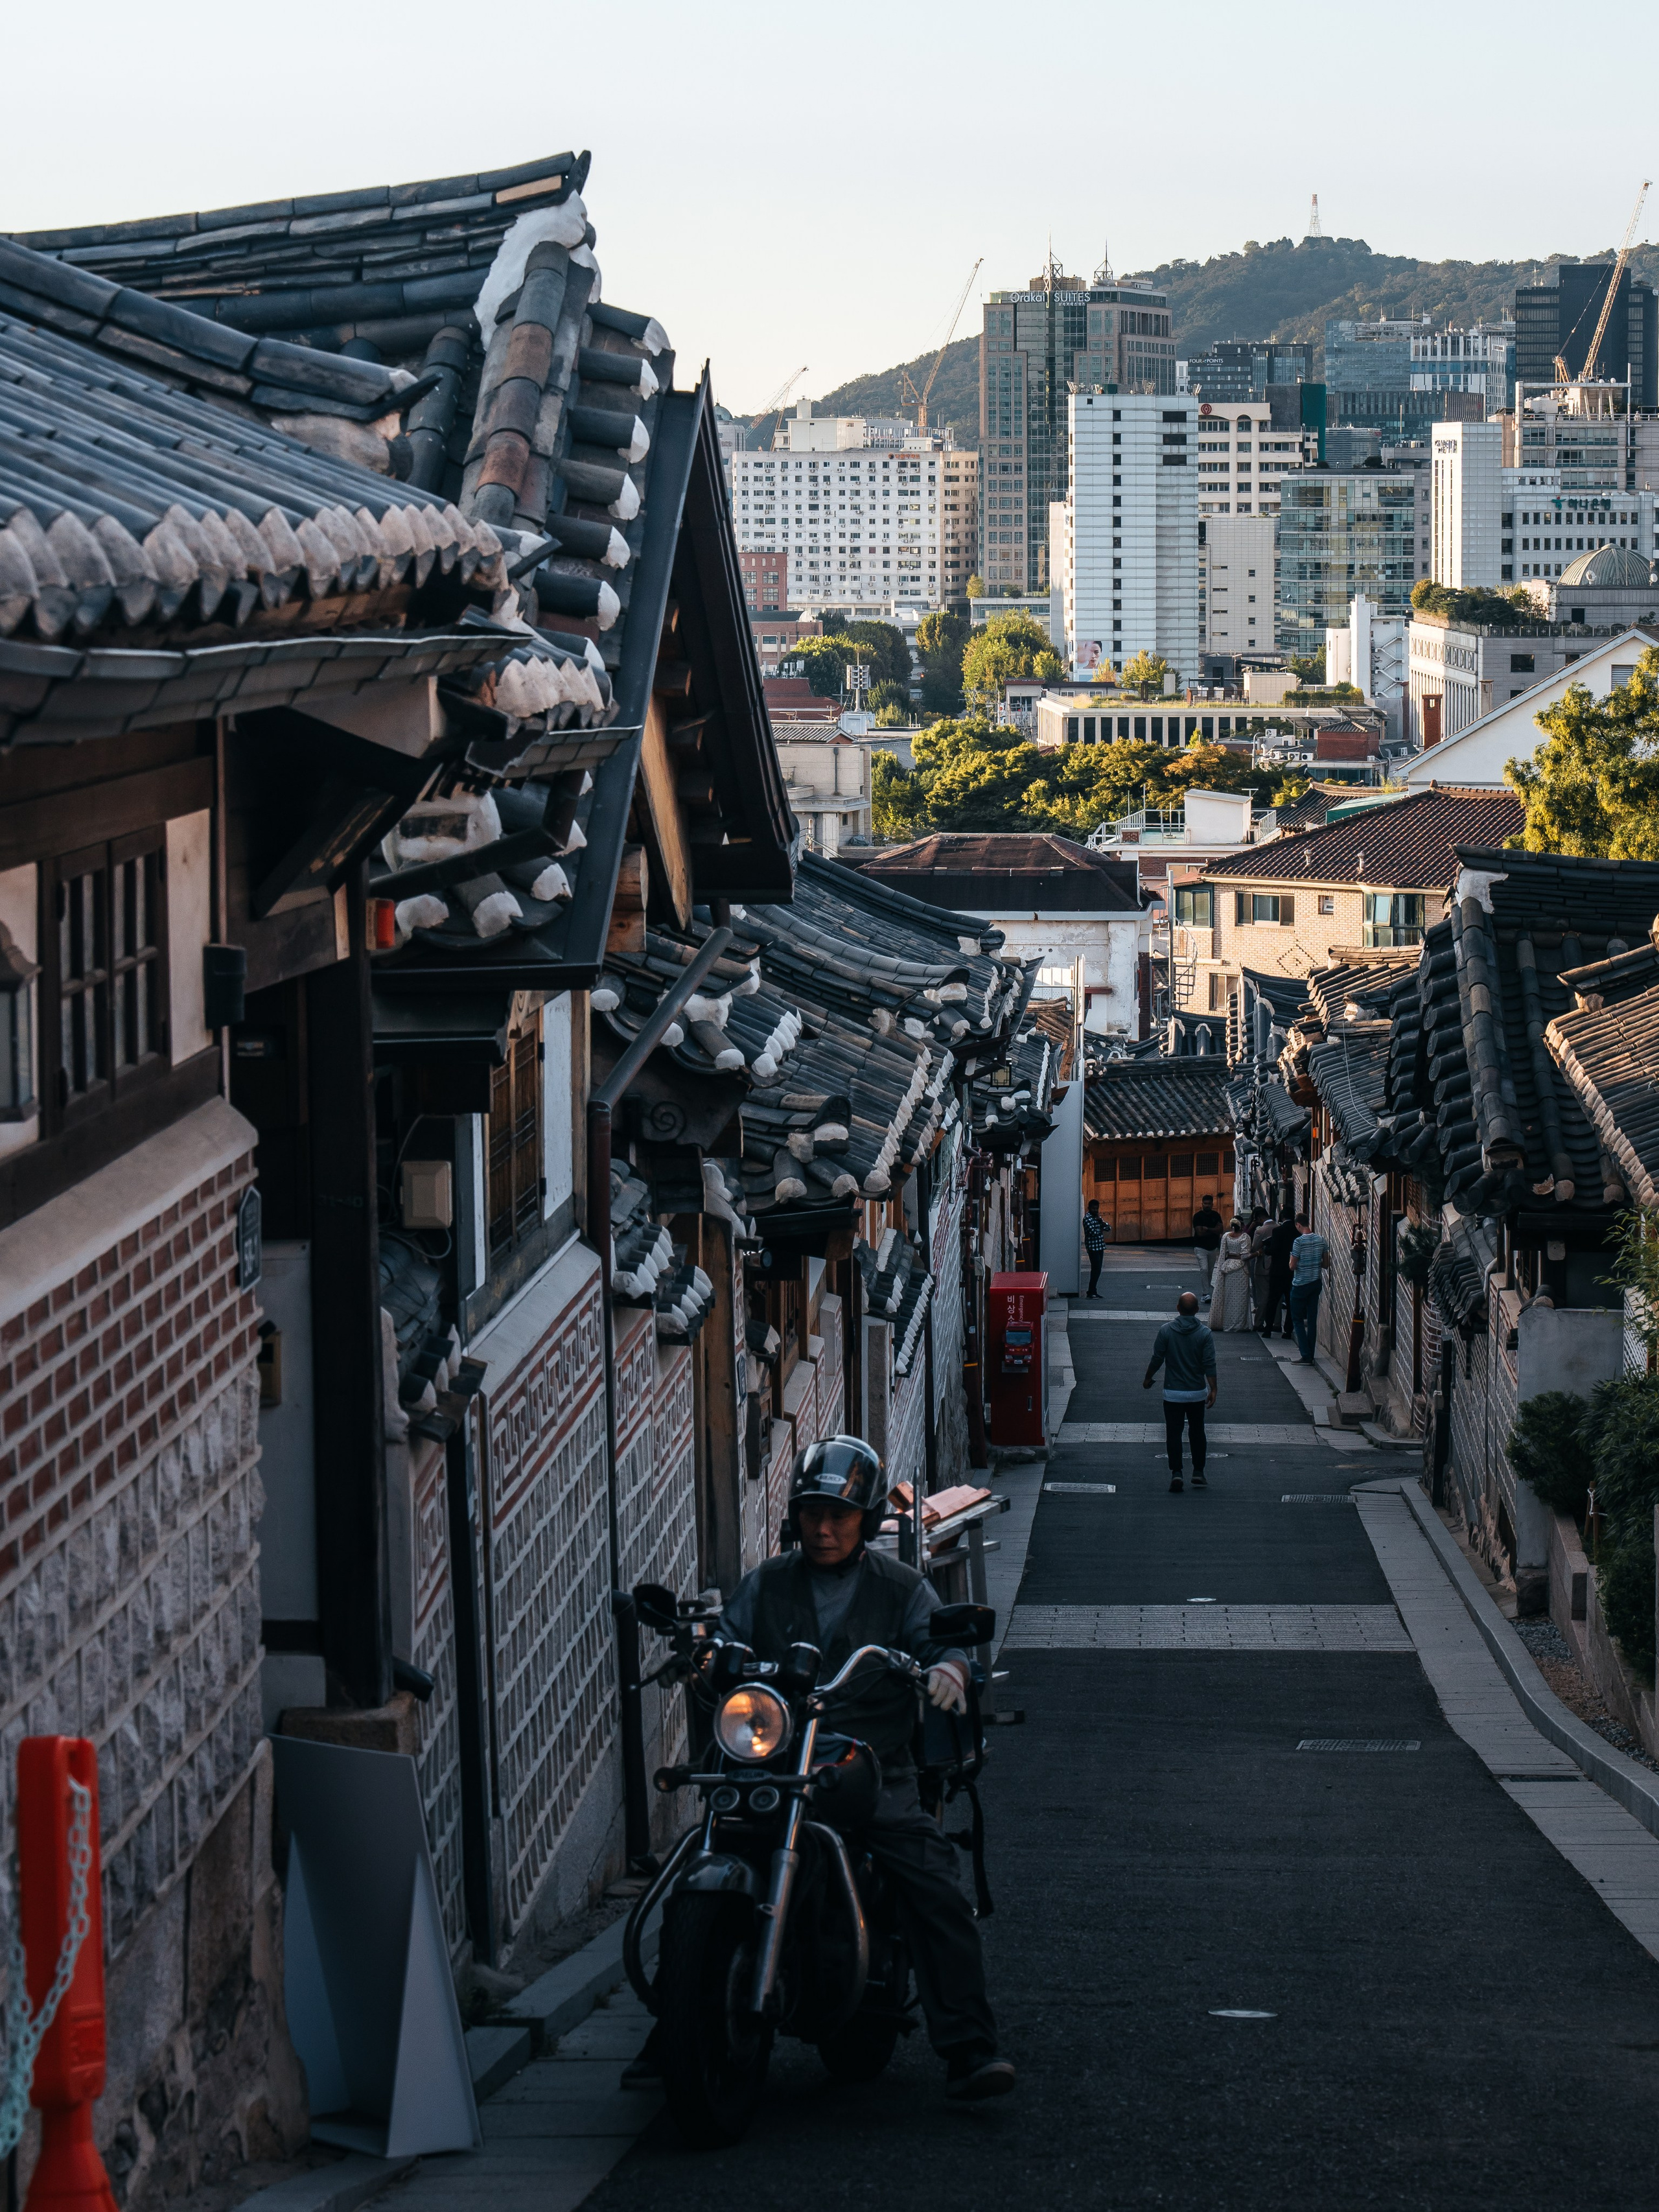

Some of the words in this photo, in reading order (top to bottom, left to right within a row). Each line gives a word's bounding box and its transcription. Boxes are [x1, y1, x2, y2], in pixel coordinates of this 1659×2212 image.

[1010, 292, 1045, 303] Orakai
[1054, 292, 1090, 302] SUITES
[1568, 498, 1611, 510] 하나은행
